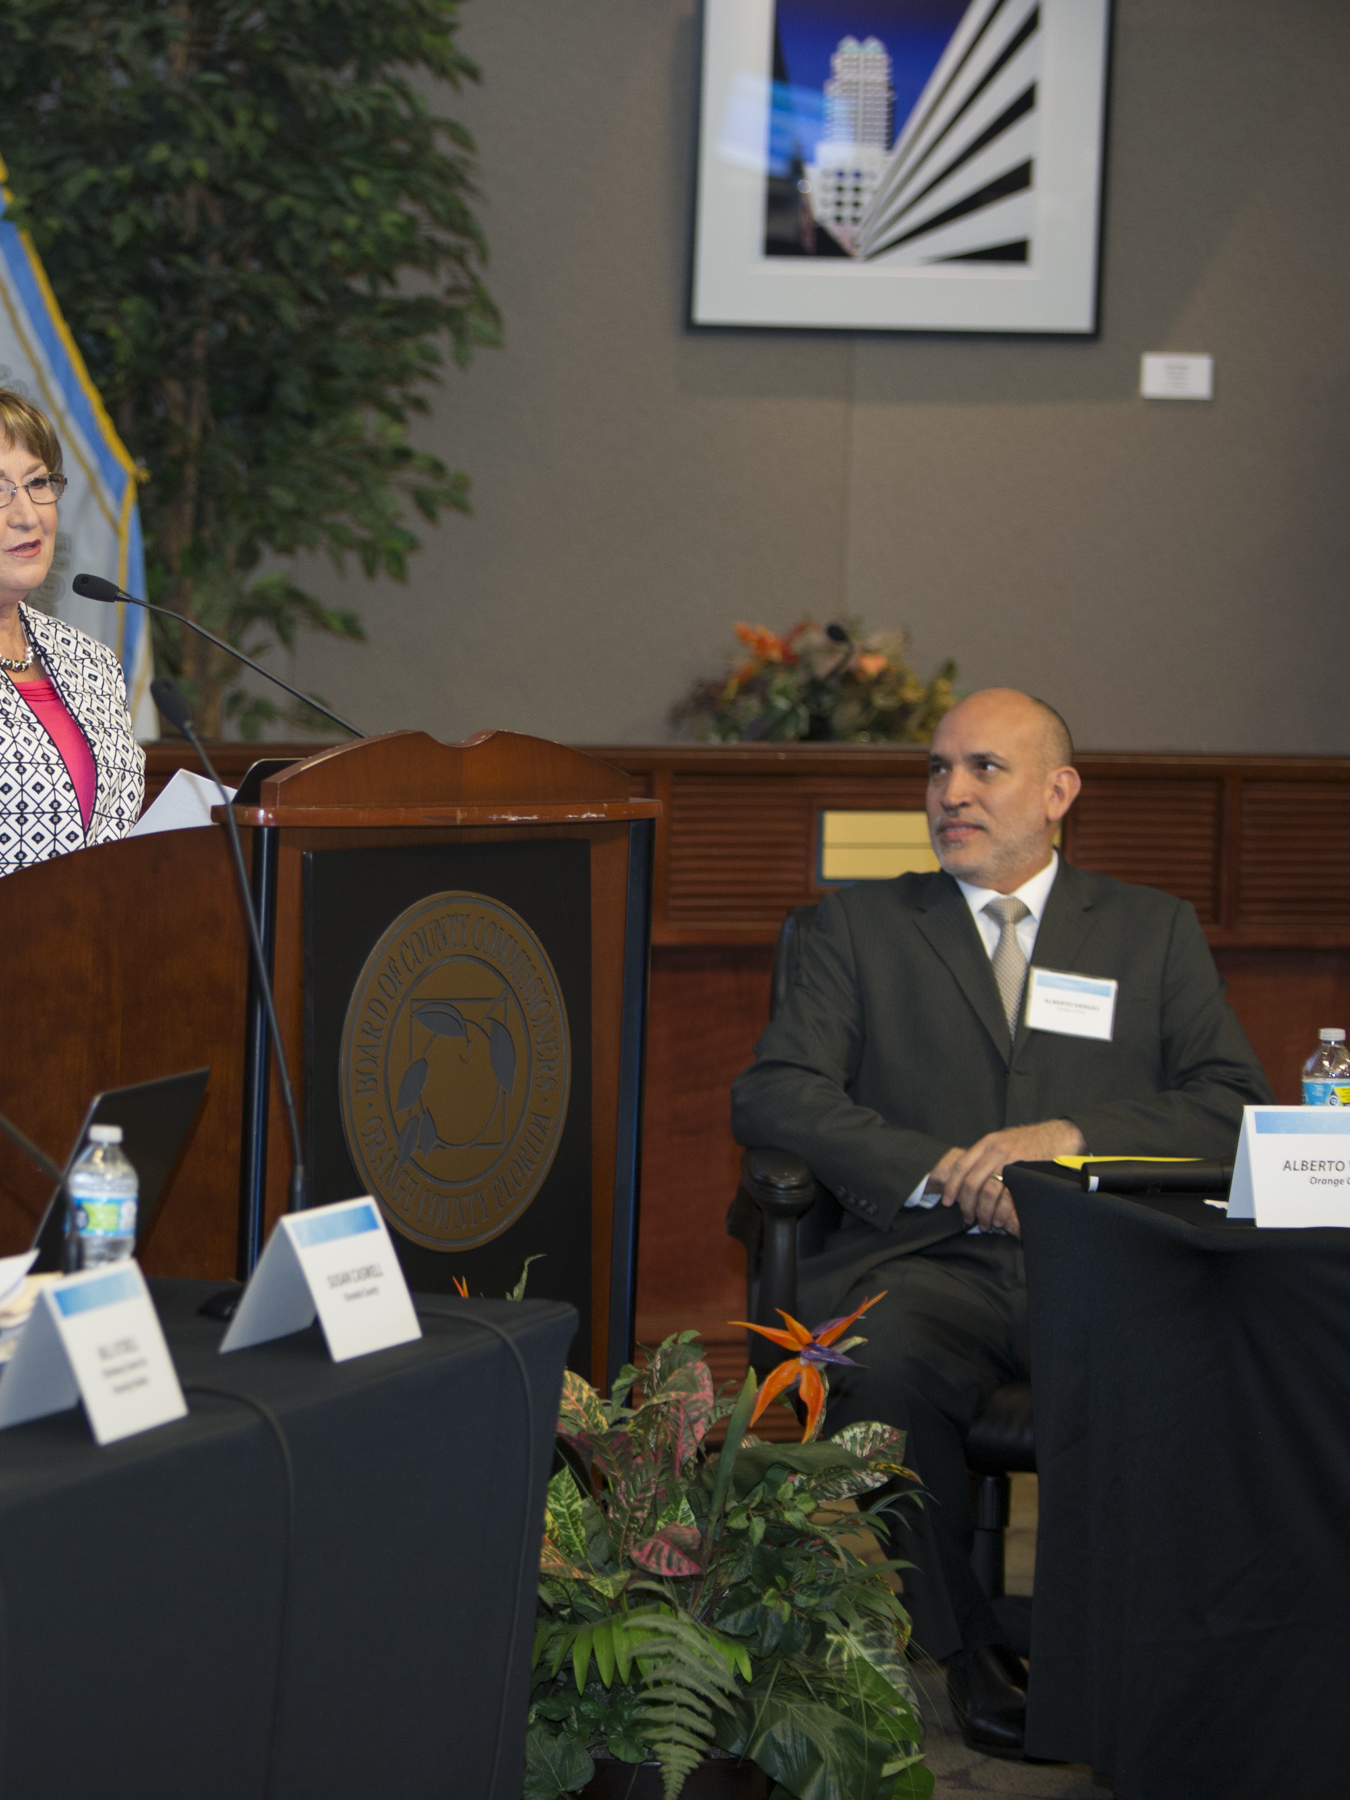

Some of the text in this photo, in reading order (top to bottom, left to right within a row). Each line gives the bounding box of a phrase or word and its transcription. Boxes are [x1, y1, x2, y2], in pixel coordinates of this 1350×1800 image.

[355, 912, 559, 1096] BOARD OF COUNTY COMMISSIONERS
[361, 1111, 555, 1230] ORANGE COUNTY FLORIDA
[1283, 1160, 1346, 1172] ALBERTO
[1309, 1176, 1345, 1188] Orange
